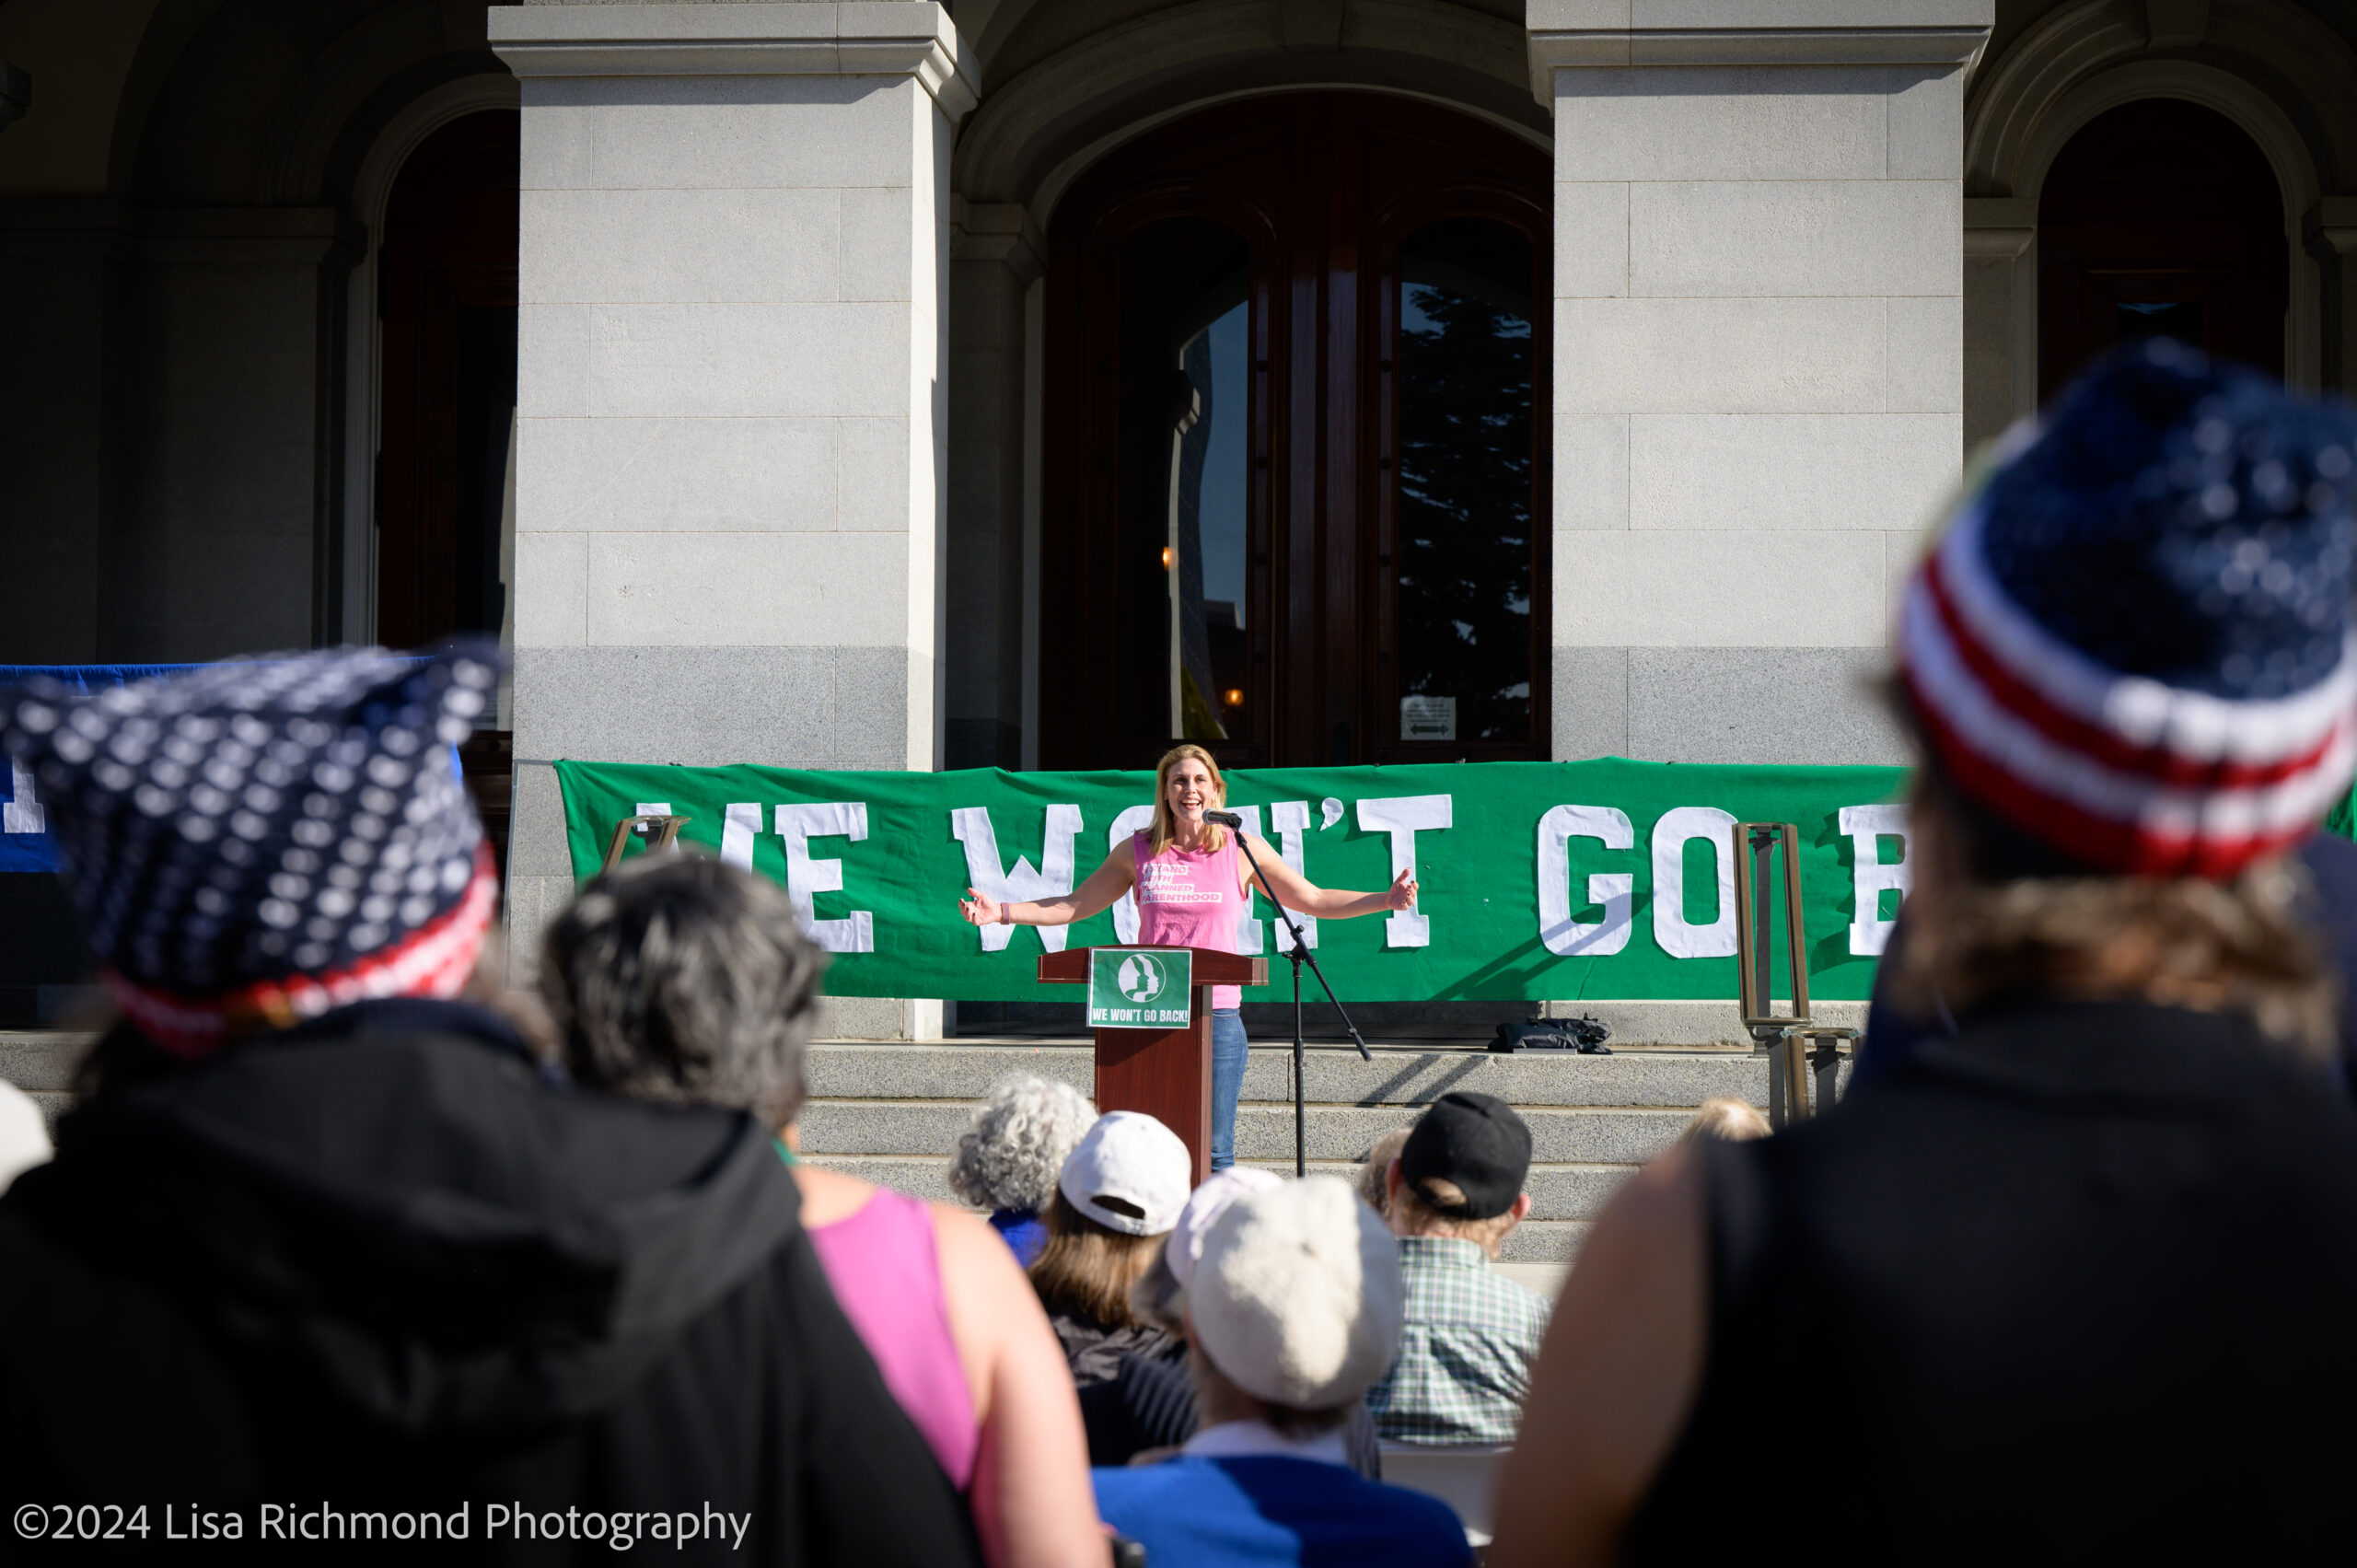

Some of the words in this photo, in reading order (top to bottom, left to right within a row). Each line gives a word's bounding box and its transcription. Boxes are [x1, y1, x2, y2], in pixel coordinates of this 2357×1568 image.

[1538, 805, 1737, 958] GO
[1142, 893, 1220, 901] PARENTHOOD
[1092, 1007, 1108, 1021] WE
[1109, 1008, 1142, 1022] WON'T
[1144, 1009, 1157, 1022] GO
[1159, 1009, 1188, 1023] BACK!
